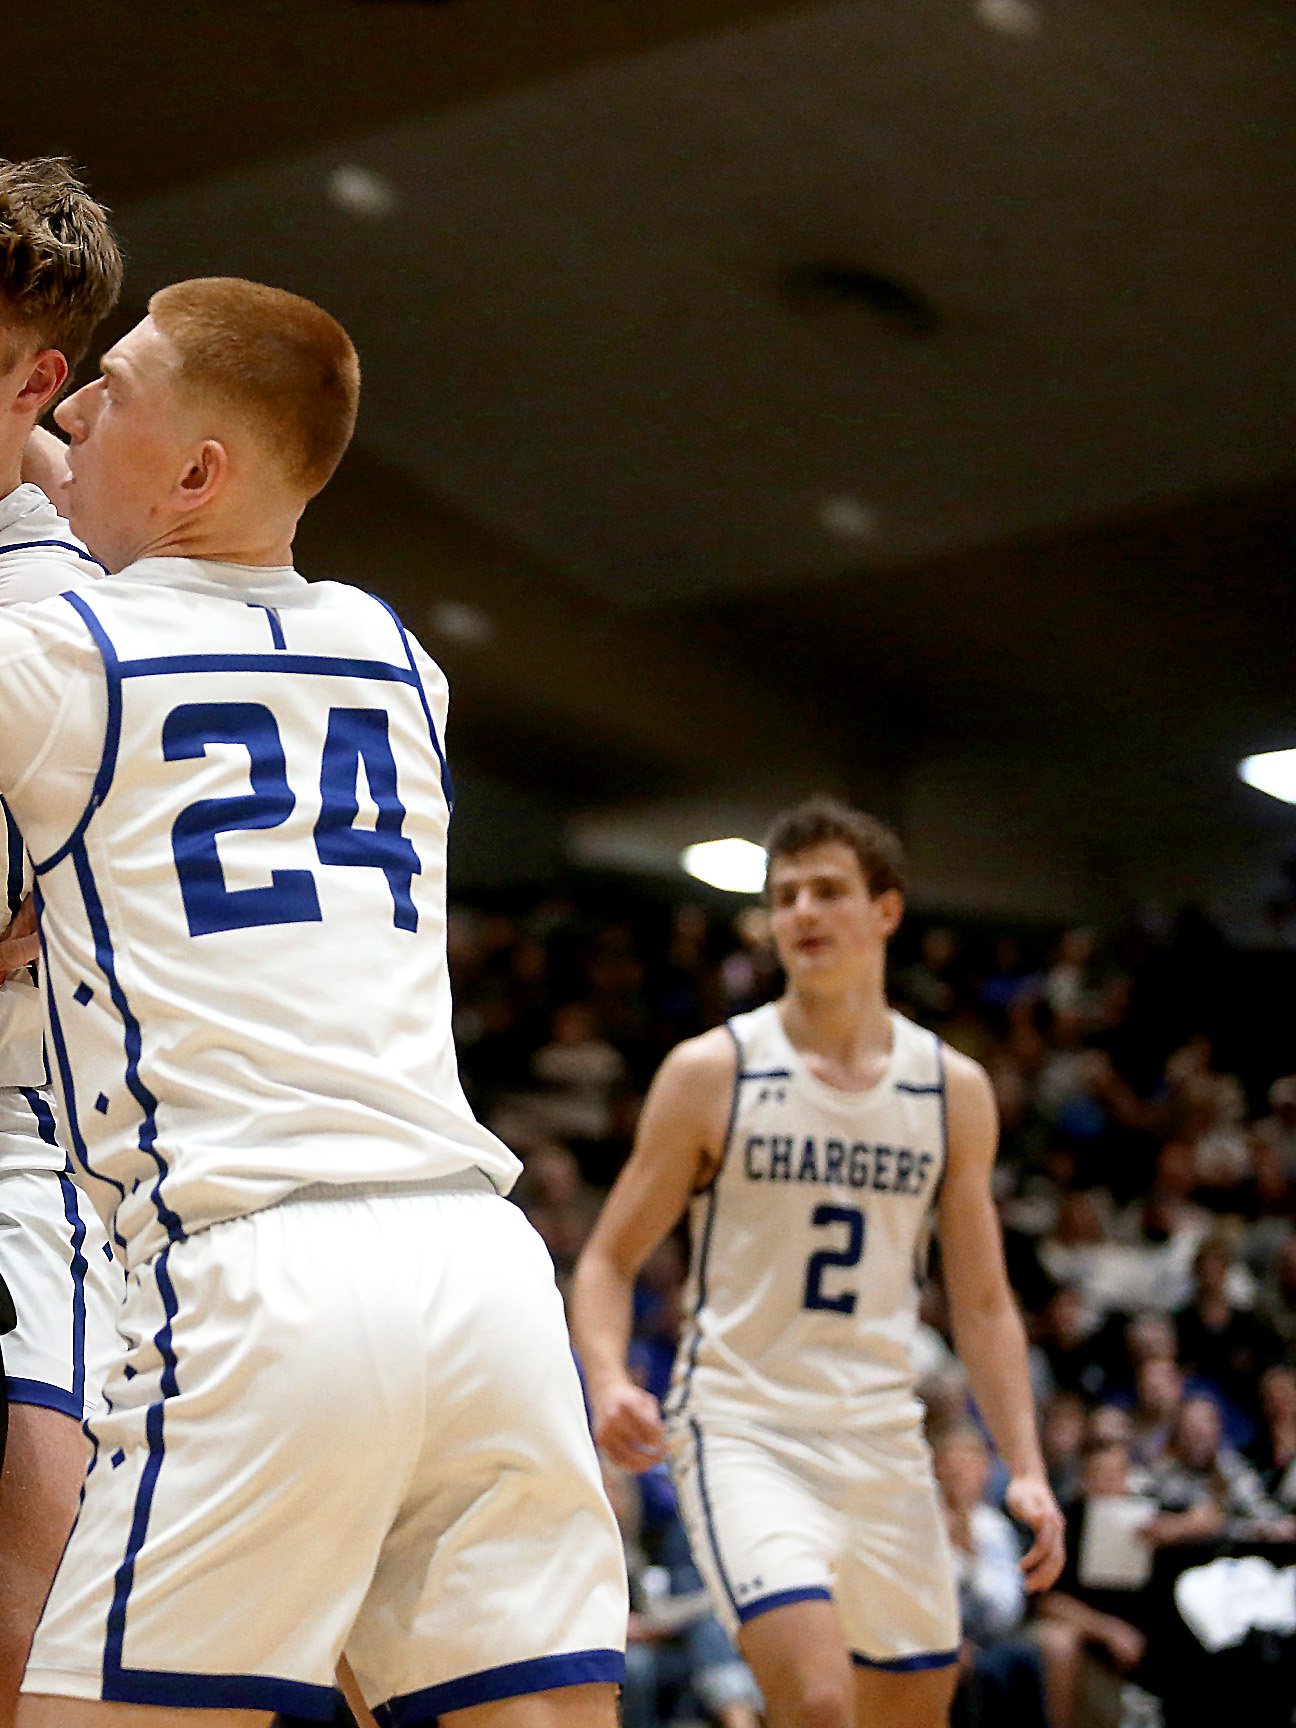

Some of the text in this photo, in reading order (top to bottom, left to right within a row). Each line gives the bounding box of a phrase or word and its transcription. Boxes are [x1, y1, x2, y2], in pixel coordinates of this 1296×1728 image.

[161, 702, 422, 937] 24
[744, 1134, 933, 1195] CHARGERS
[803, 1204, 865, 1315] 2
